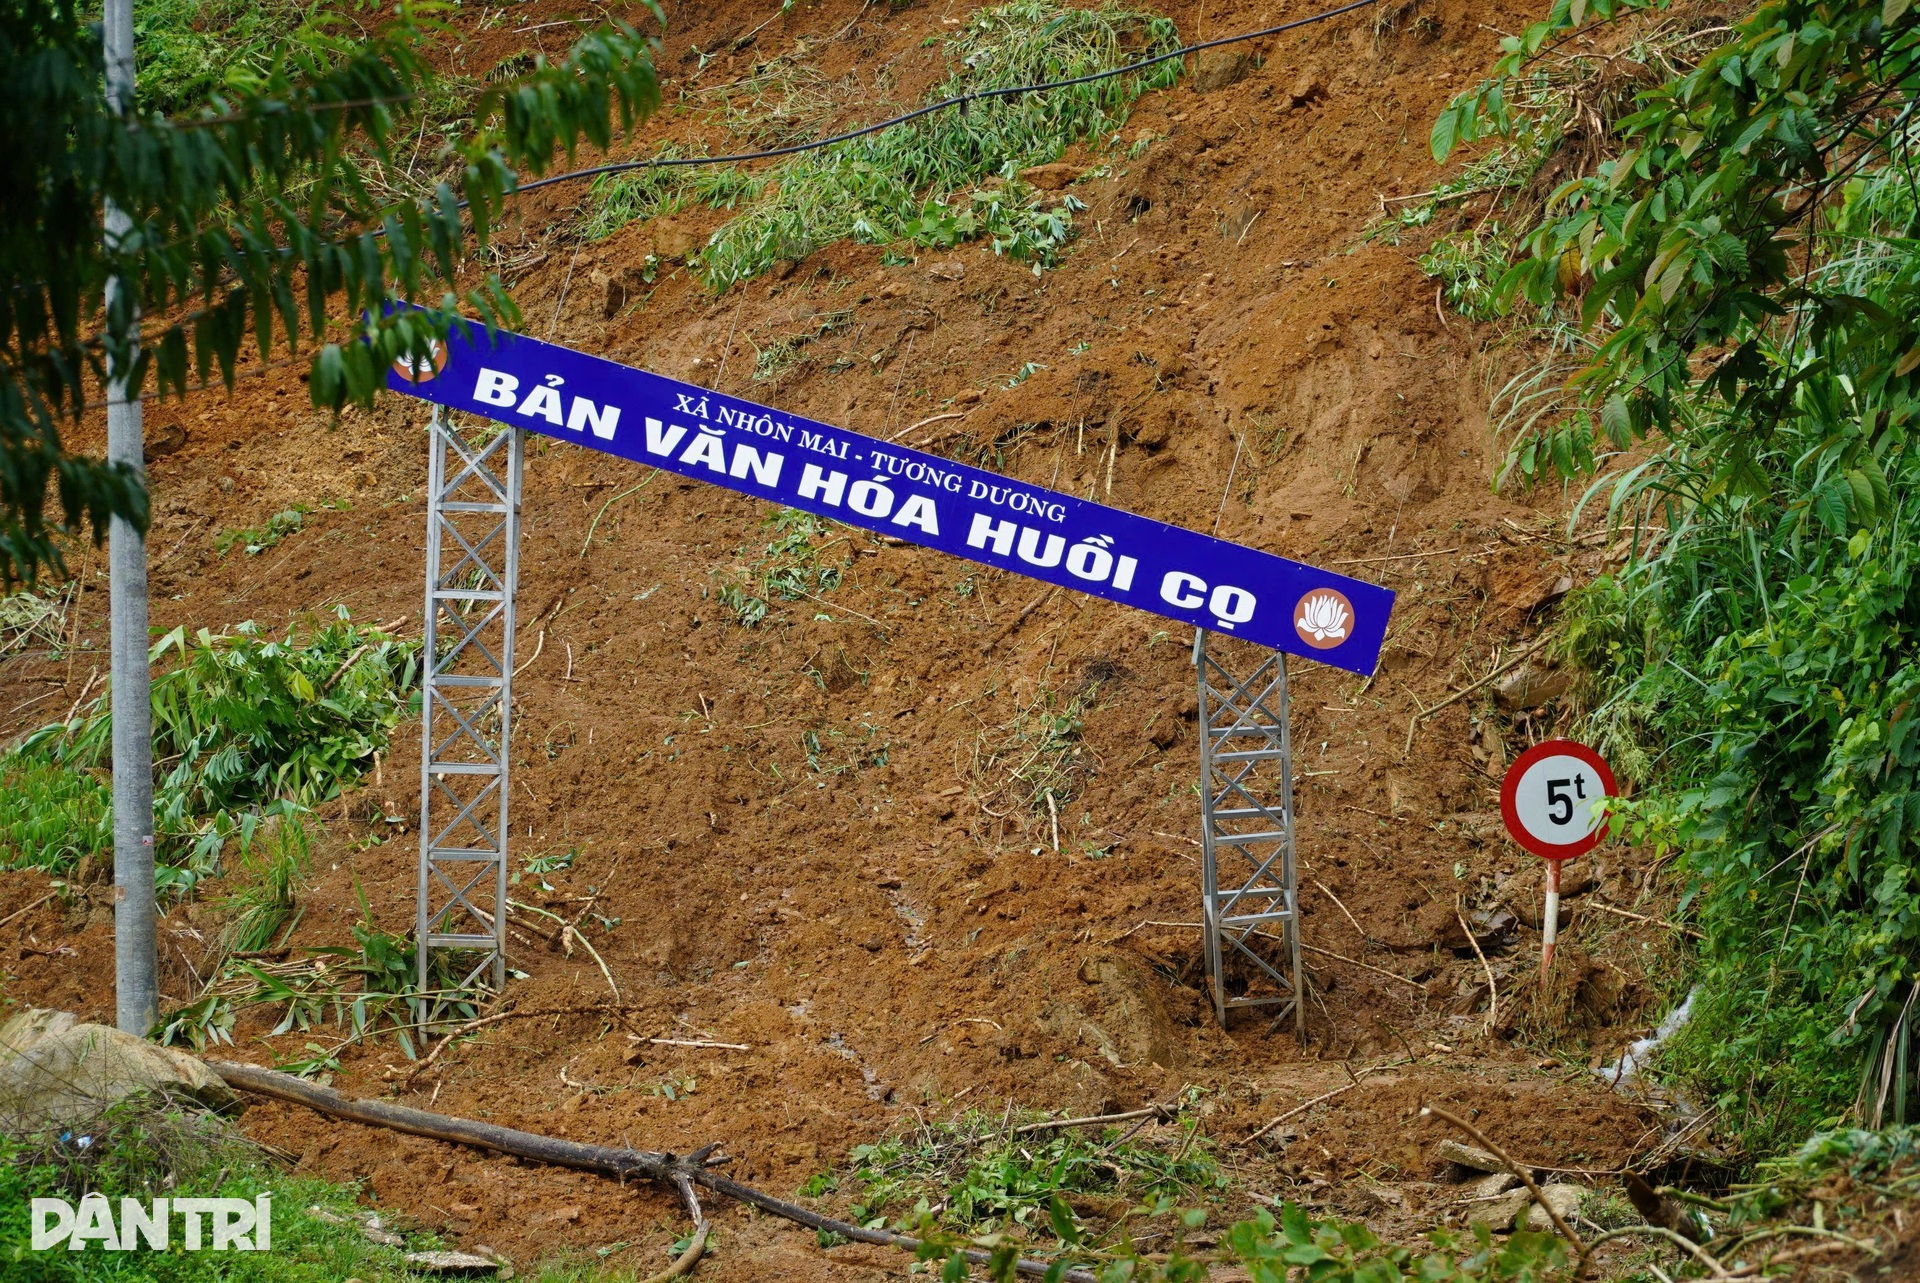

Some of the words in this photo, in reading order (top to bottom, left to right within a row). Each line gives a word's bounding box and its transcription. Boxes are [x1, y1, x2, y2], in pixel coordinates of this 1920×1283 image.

[472, 367, 622, 441] BẢN
[645, 416, 785, 488] VĂN
[797, 462, 940, 536] HÓA
[966, 512, 1138, 592] HUỒI
[1159, 571, 1257, 630] CỌ
[673, 393, 710, 420] XÃ
[715, 405, 795, 443] NHÔN
[797, 430, 851, 460] MAI
[870, 450, 963, 494] TƯƠNG
[967, 480, 1066, 524] DƯƠNG
